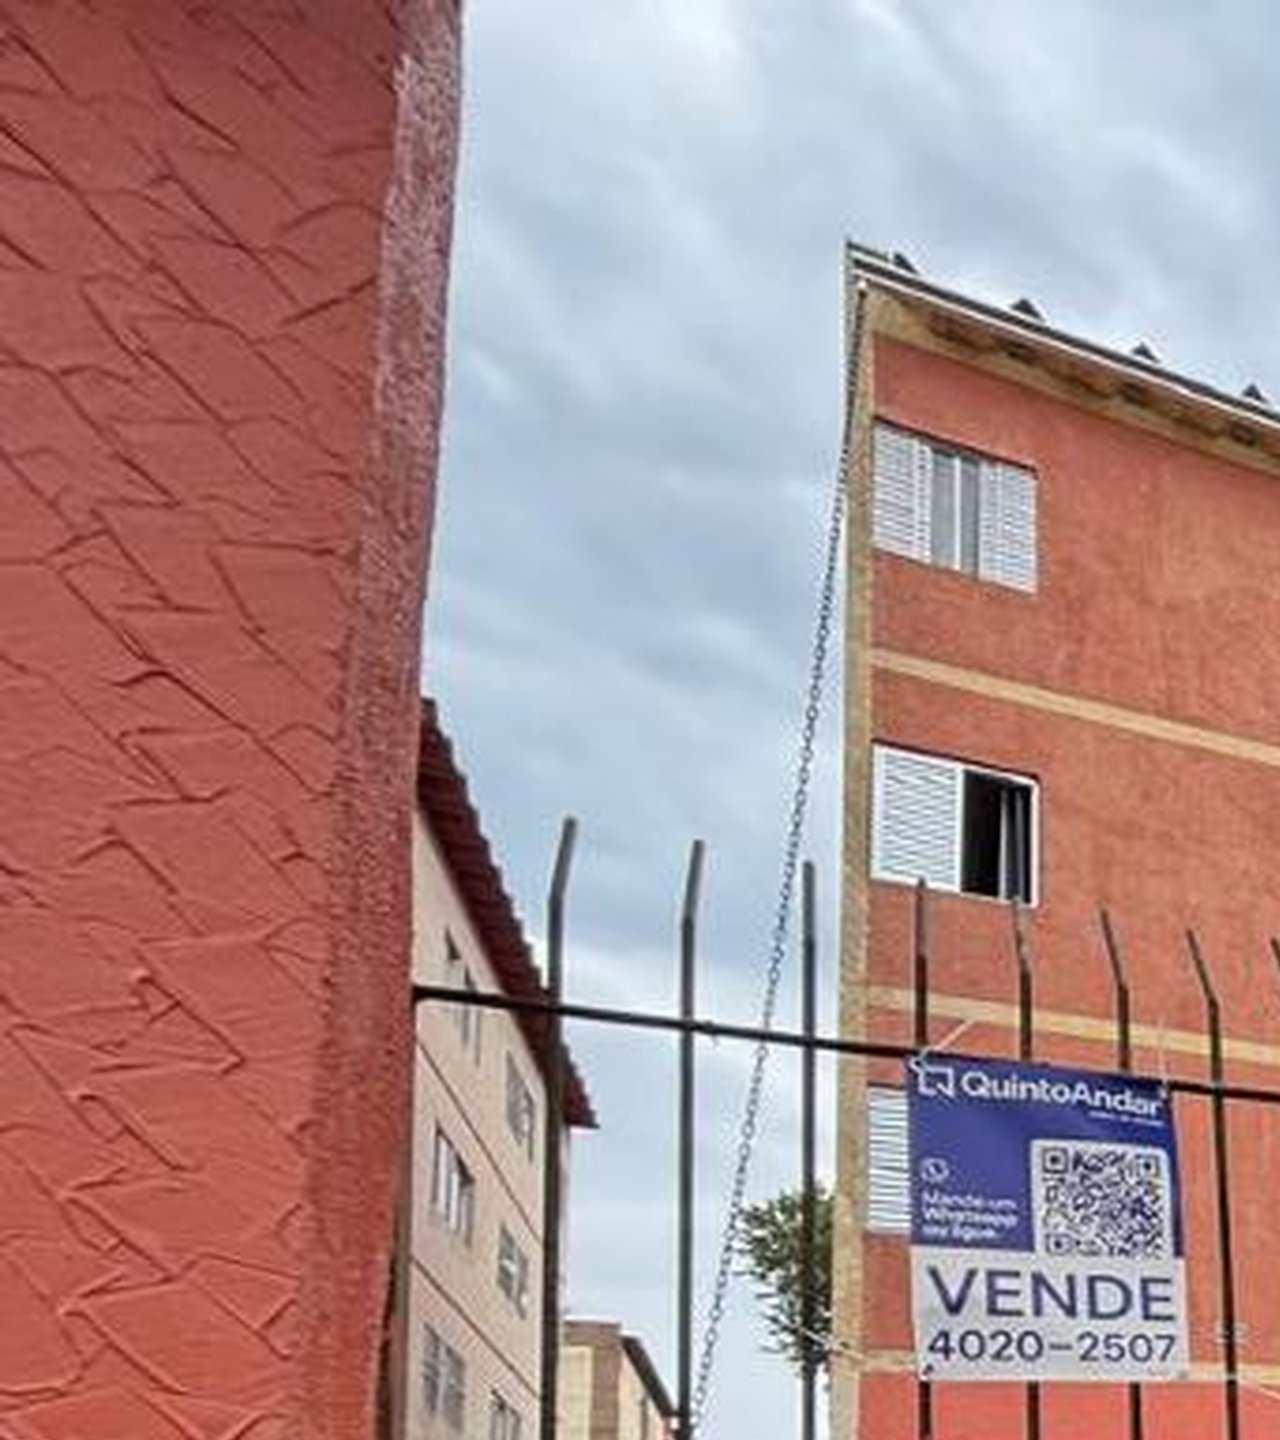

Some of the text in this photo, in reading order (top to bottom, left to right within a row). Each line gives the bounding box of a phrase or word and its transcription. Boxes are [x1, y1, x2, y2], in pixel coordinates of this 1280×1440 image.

[961, 1071, 1163, 1116] QuintoAndar
[927, 1266, 1176, 1321] VENDE
[928, 1329, 1176, 1362] 4020-2507
